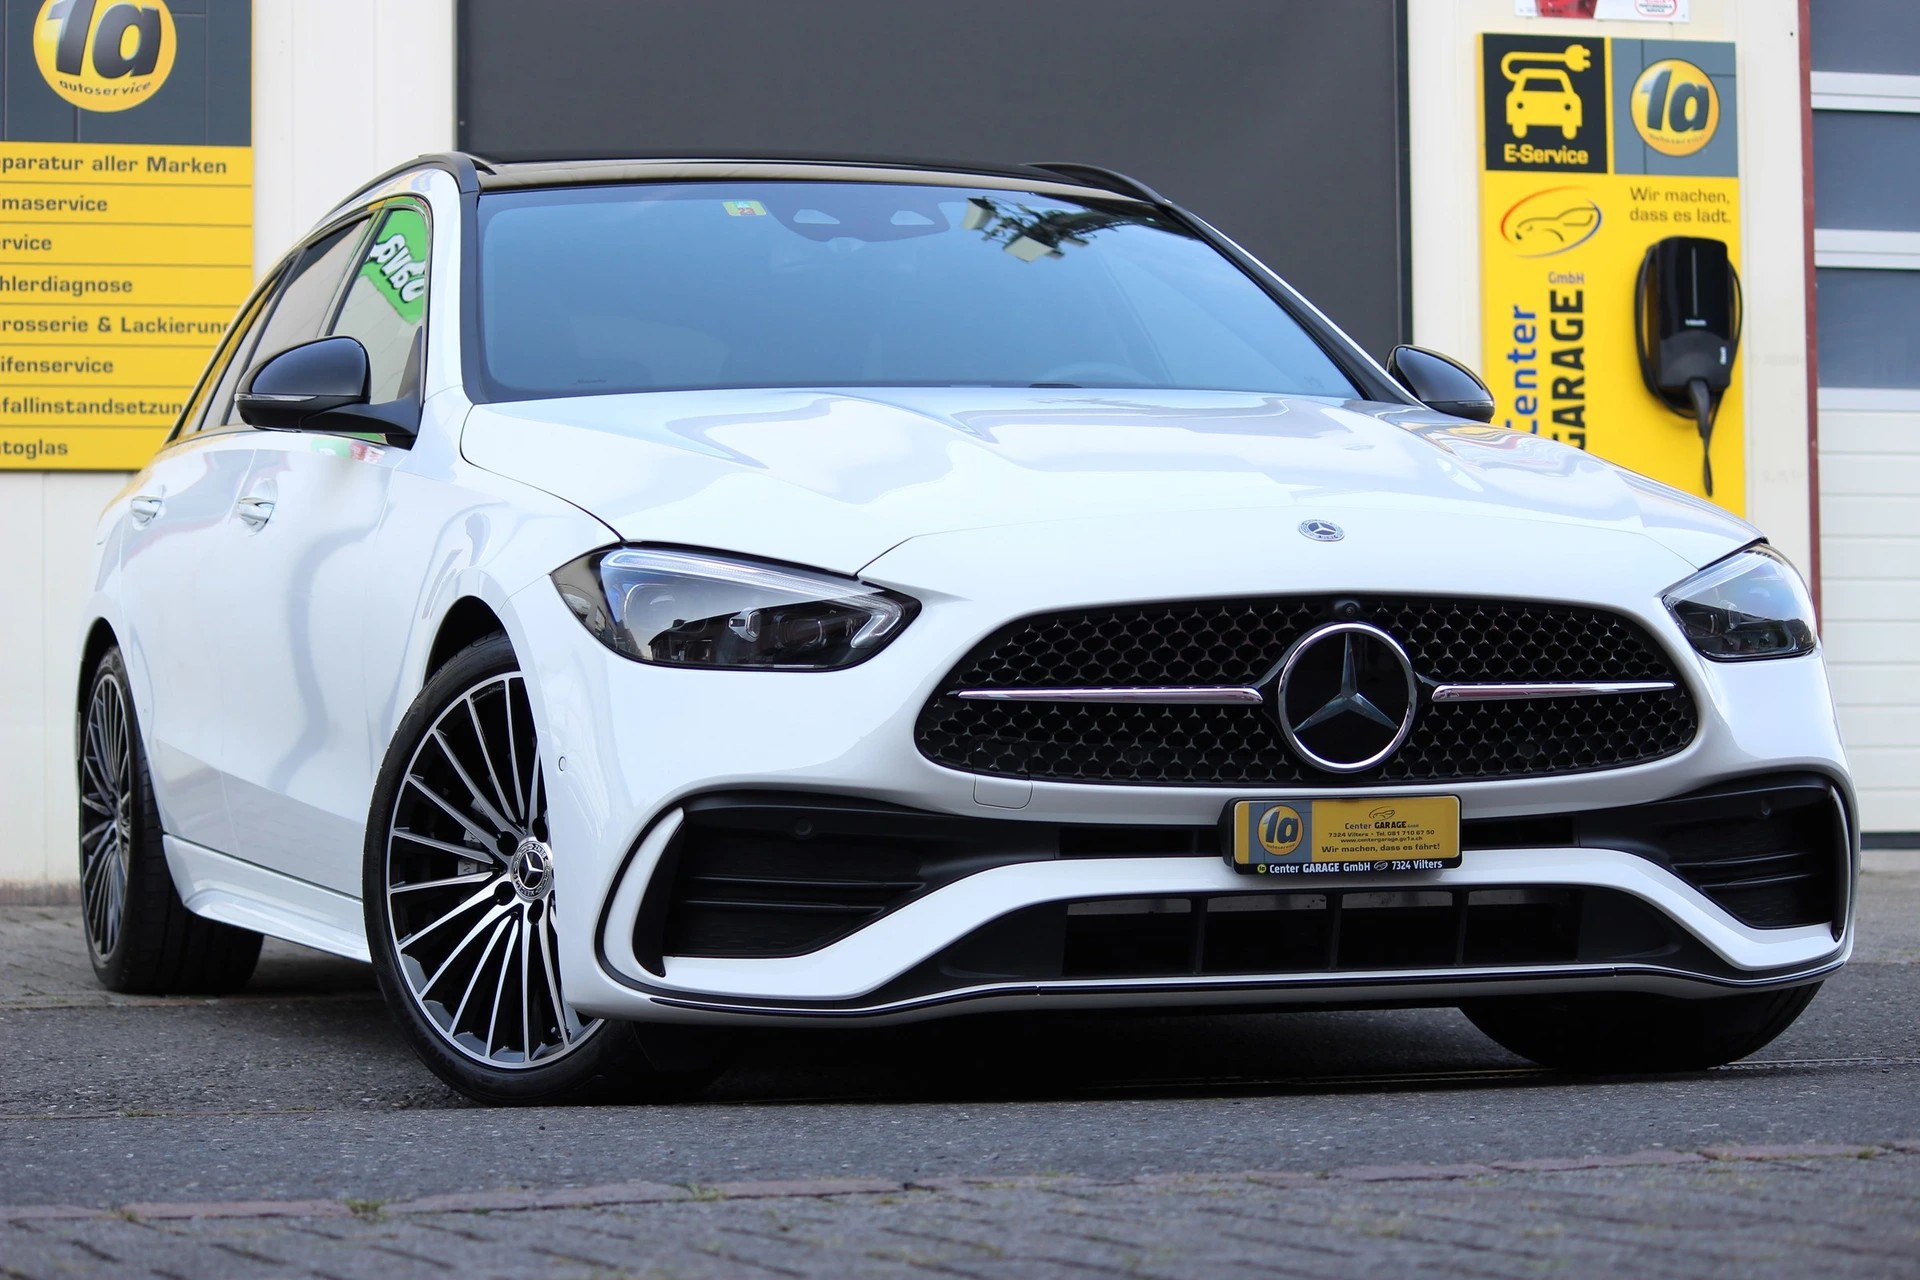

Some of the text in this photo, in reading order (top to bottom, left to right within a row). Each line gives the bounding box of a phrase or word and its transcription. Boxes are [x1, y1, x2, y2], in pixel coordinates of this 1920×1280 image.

[59, 80, 151, 96] autoservice
[1640, 69, 1710, 133] 1a
[1503, 143, 1589, 165] E-Service
[0, 155, 227, 174] paratur aller Marken
[0, 195, 108, 212] maservice
[1629, 186, 1731, 205] Wir machen,
[1629, 207, 1668, 222] dass
[1673, 210, 1692, 222] es
[0, 234, 52, 251] rvice
[1549, 271, 1585, 284] GmbH
[0, 316, 88, 333] rosserie
[97, 316, 112, 333] &
[1, 355, 114, 373] ifenservice
[0, 397, 183, 415] fallinstandsetzun
[0, 439, 68, 459] toglas
[1263, 810, 1299, 844] 1a
[1344, 822, 1371, 830] Center
[1374, 820, 1407, 829] GARAGE
[1321, 845, 1339, 853] Wir
[1341, 844, 1378, 853] machen,
[1380, 844, 1401, 852] dass
[1269, 863, 1299, 874] Center
[1302, 862, 1340, 873] GARAGE
[1343, 861, 1371, 872] GmbH
[1391, 860, 1411, 870] 7324
[1413, 859, 1443, 869] Vilters
